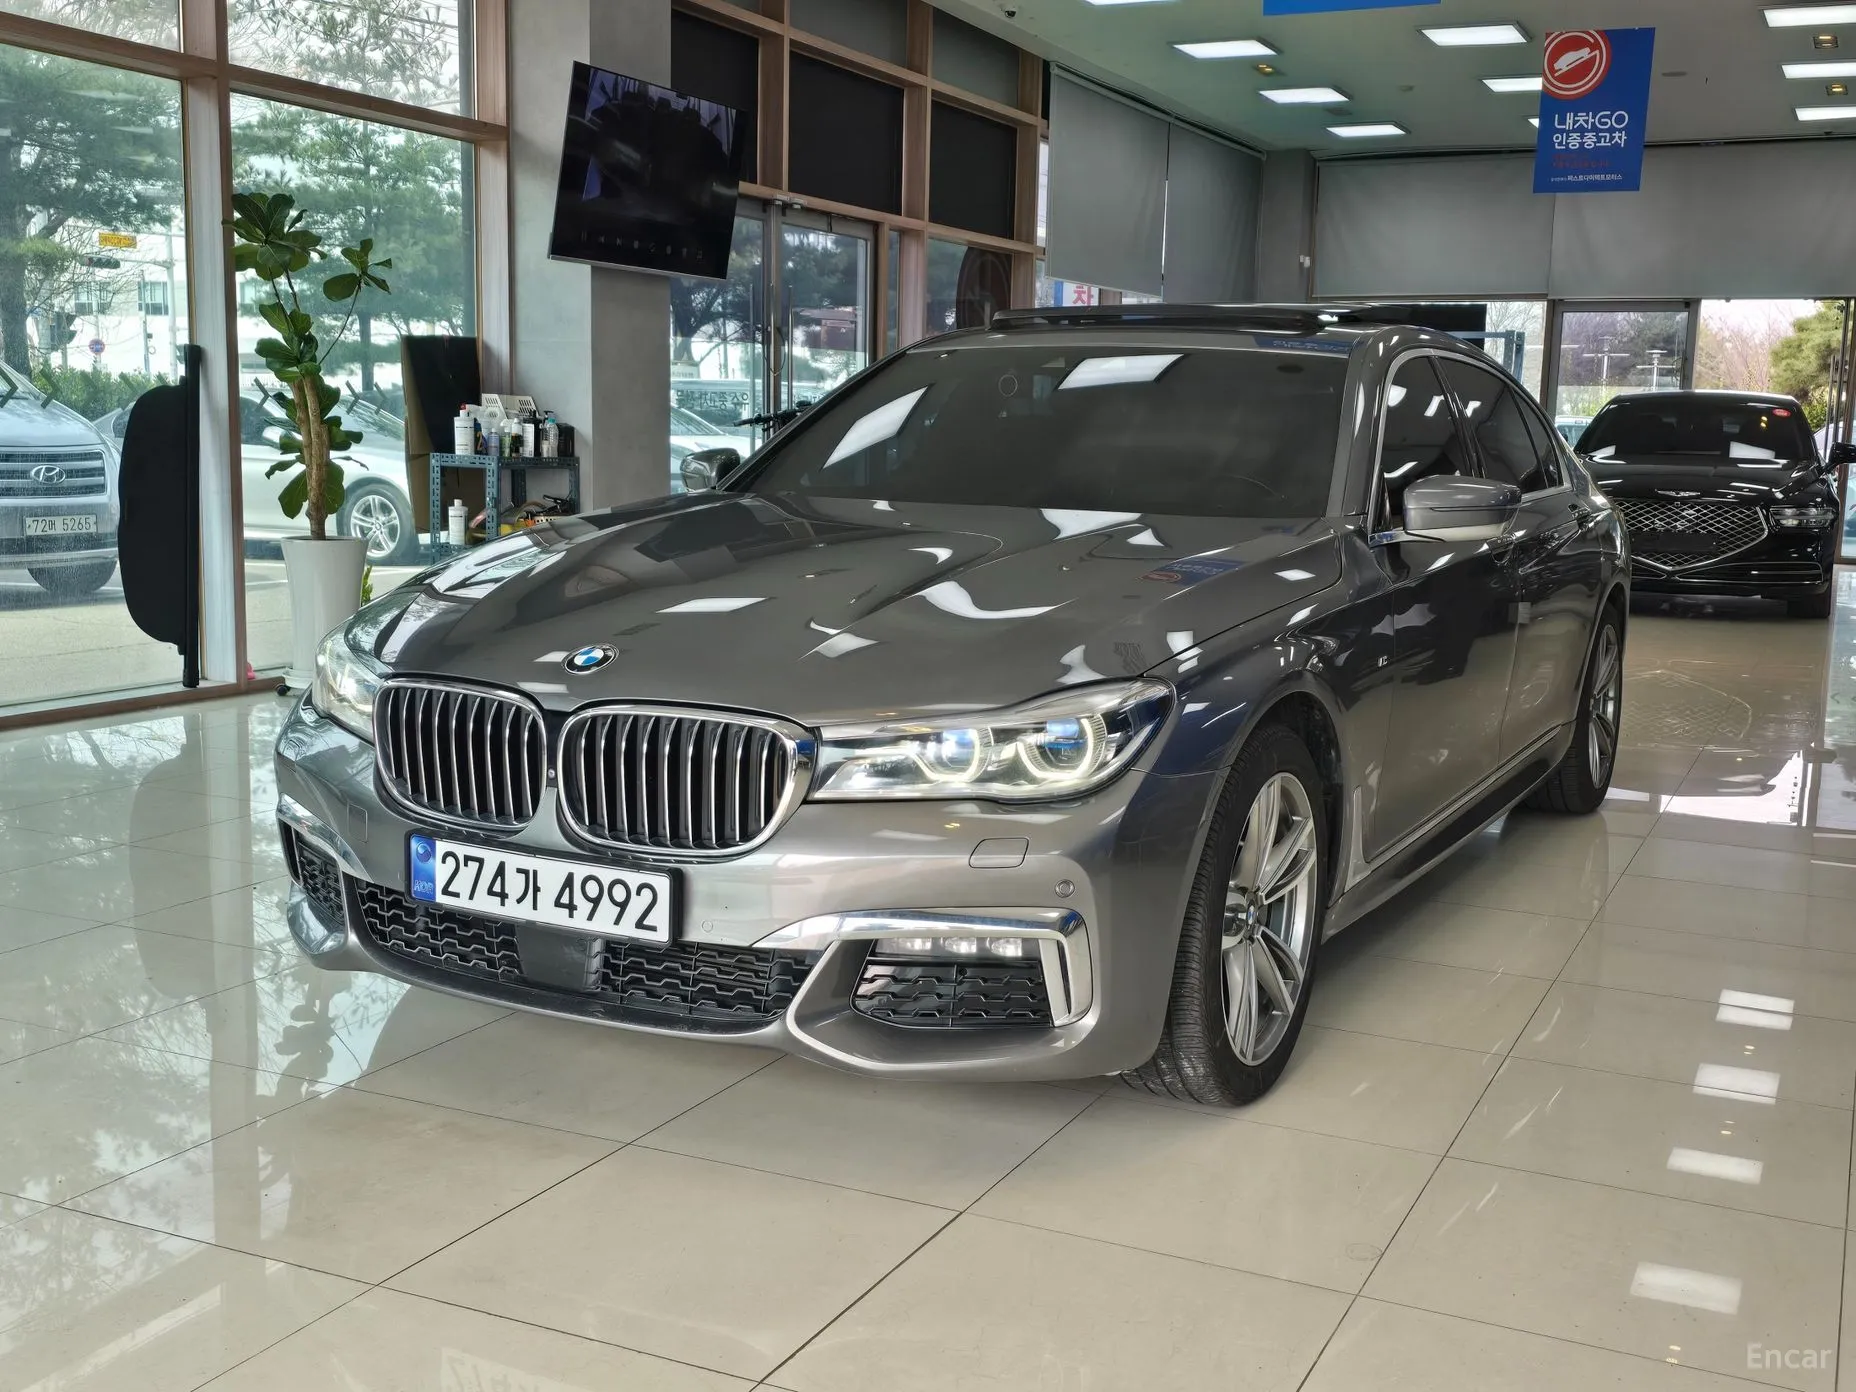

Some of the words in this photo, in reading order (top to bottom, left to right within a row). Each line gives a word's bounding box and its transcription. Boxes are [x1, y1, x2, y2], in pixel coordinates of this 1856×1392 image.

[1554, 110, 1629, 130] 내차GO
[1553, 130, 1627, 149] 인증중고차
[62, 517, 91, 531] 5265
[441, 850, 541, 911] 274가
[553, 871, 659, 933] 4992
